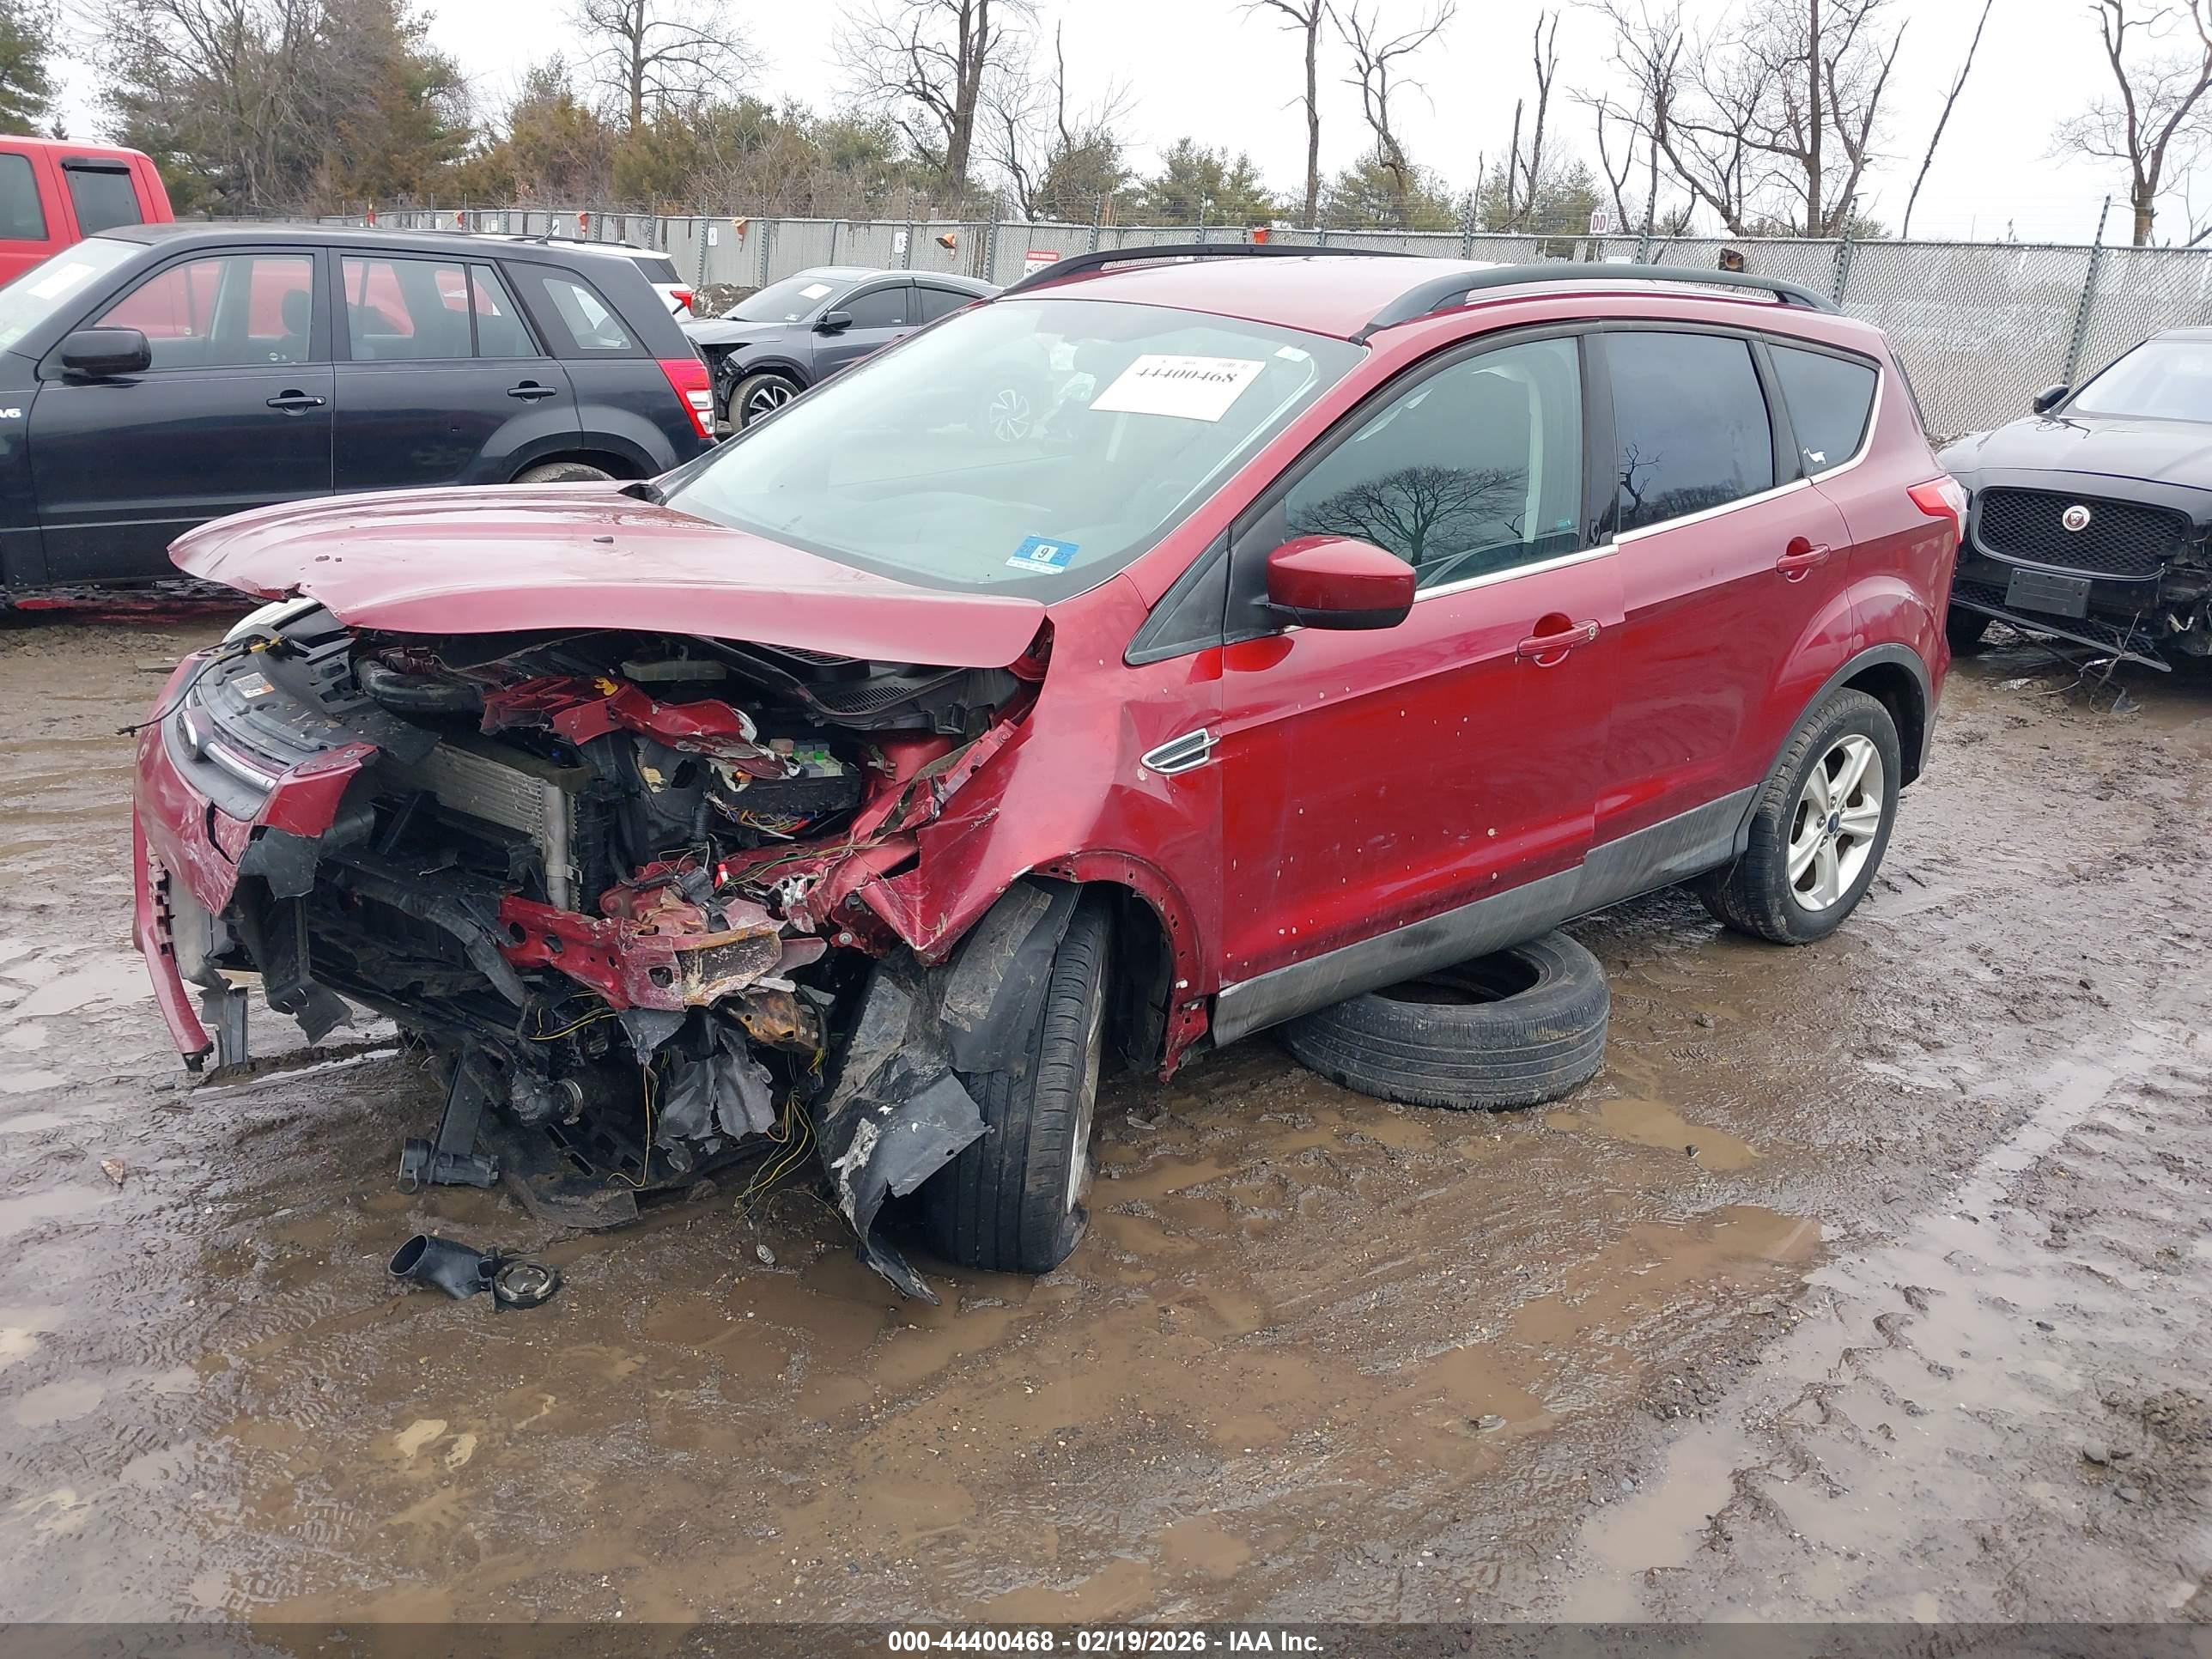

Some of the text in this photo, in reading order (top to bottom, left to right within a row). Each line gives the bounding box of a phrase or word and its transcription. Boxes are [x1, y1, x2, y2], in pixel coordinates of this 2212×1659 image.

[1592, 214, 1607, 231] DD
[1135, 367, 1238, 384] 44400468
[1037, 547, 1049, 558] 9
